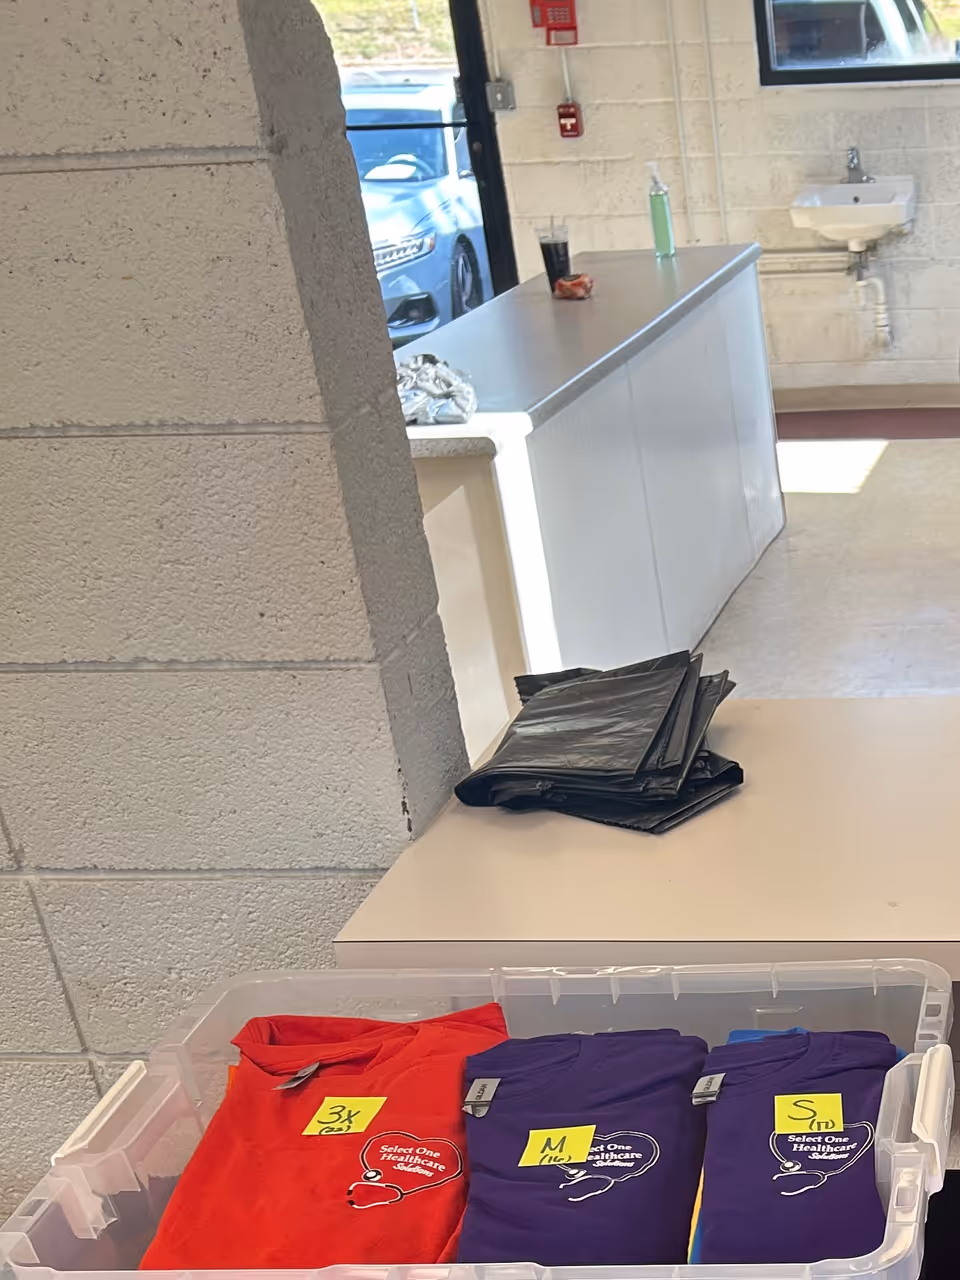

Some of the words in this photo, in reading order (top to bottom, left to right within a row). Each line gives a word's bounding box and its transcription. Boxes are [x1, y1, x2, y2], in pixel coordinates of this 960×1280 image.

[787, 1099, 817, 1120] S
[540, 1136, 566, 1153] M
[590, 1144, 604, 1152] ect
[792, 1143, 857, 1152] Healthcare
[379, 1145, 414, 1154] Select
[416, 1147, 440, 1158] One
[587, 1152, 642, 1160] ealthcare
[380, 1153, 446, 1172] Healthcare
[393, 1163, 434, 1177] Solutions
